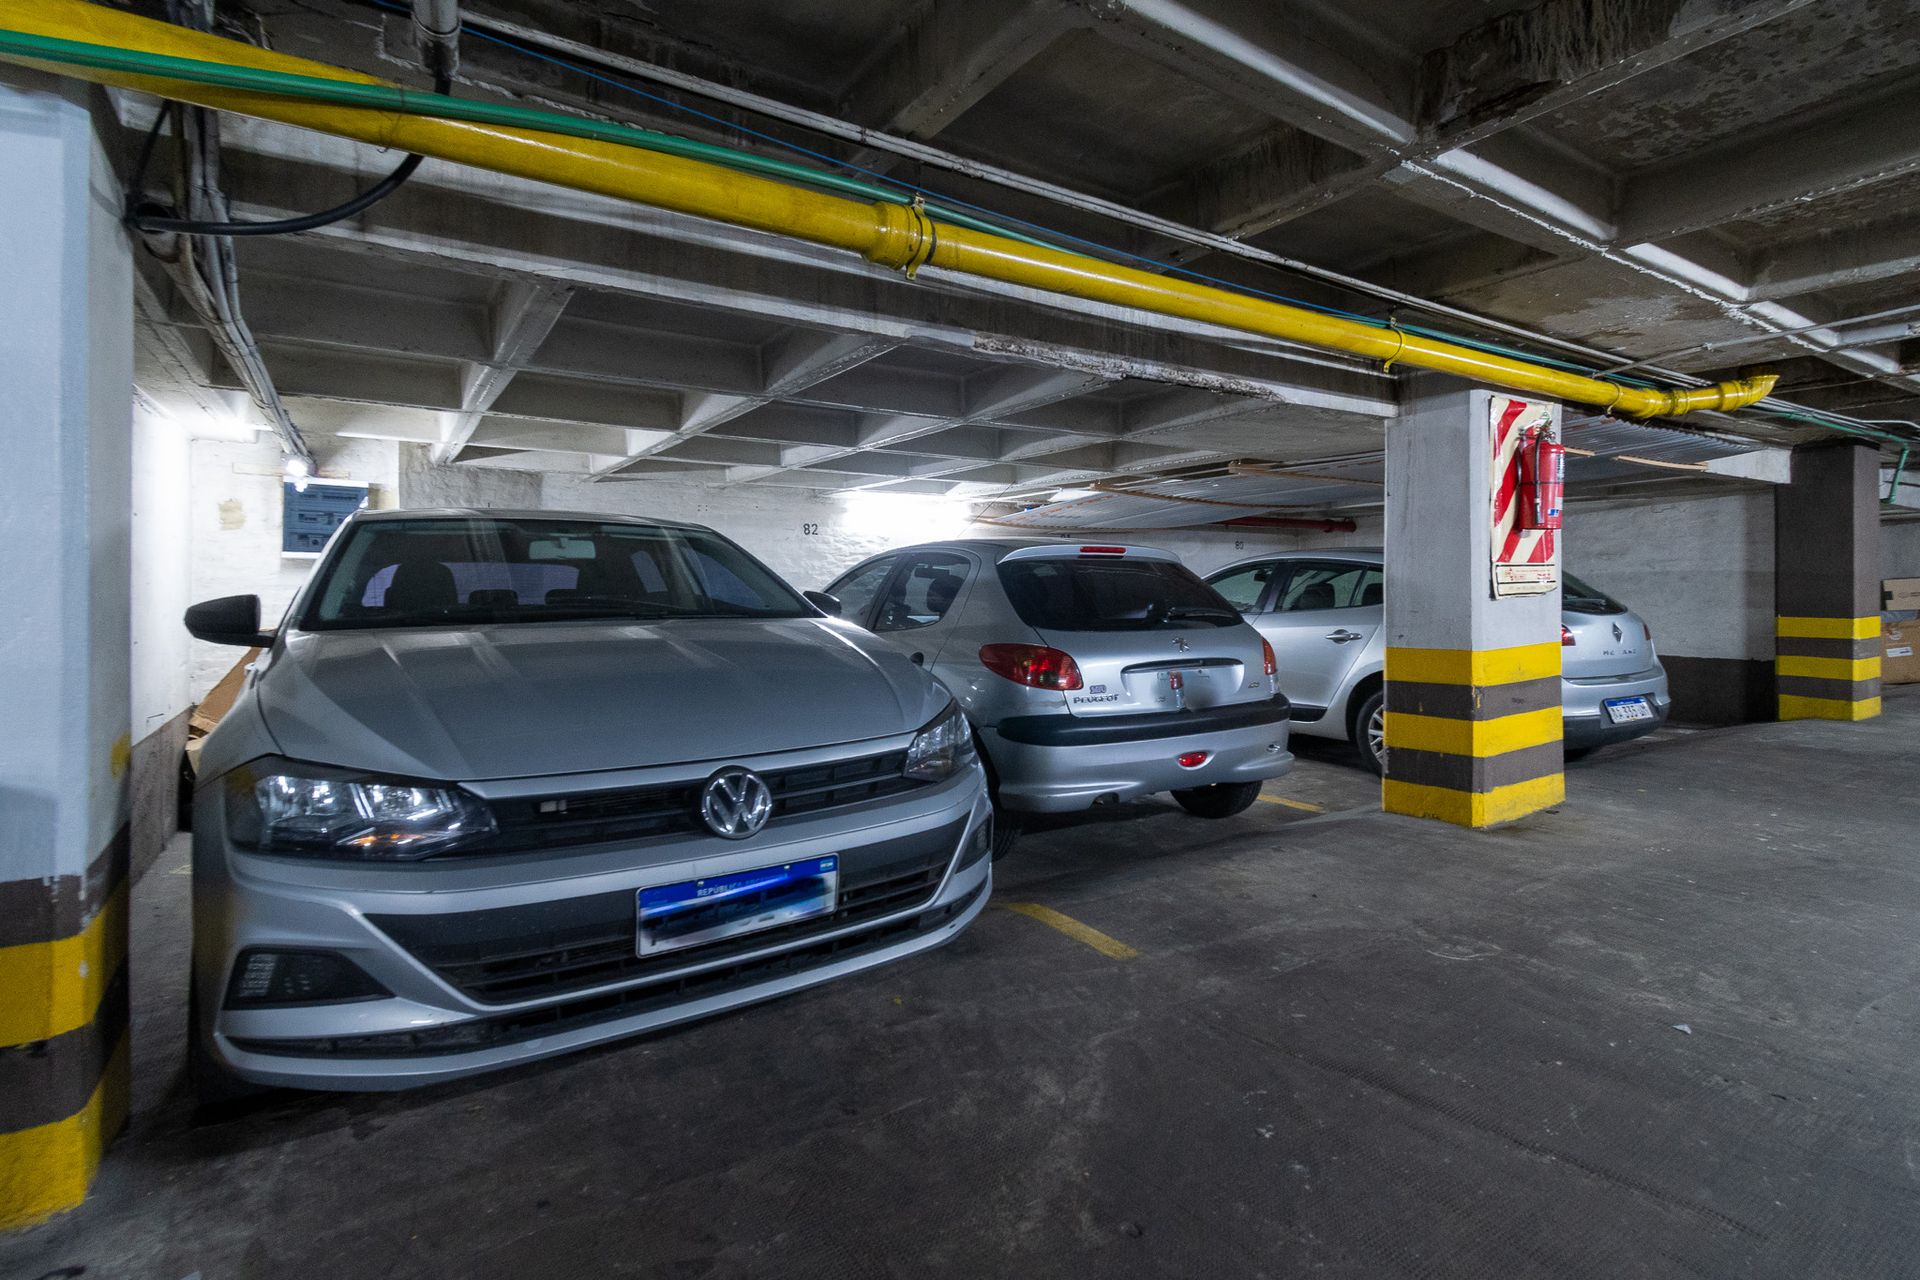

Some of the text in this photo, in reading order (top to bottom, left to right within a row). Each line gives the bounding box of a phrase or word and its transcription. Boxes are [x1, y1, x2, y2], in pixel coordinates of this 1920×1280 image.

[803, 523, 818, 536] 82
[1235, 541, 1244, 550] 80
[1073, 694, 1119, 704] PEUGEOT
